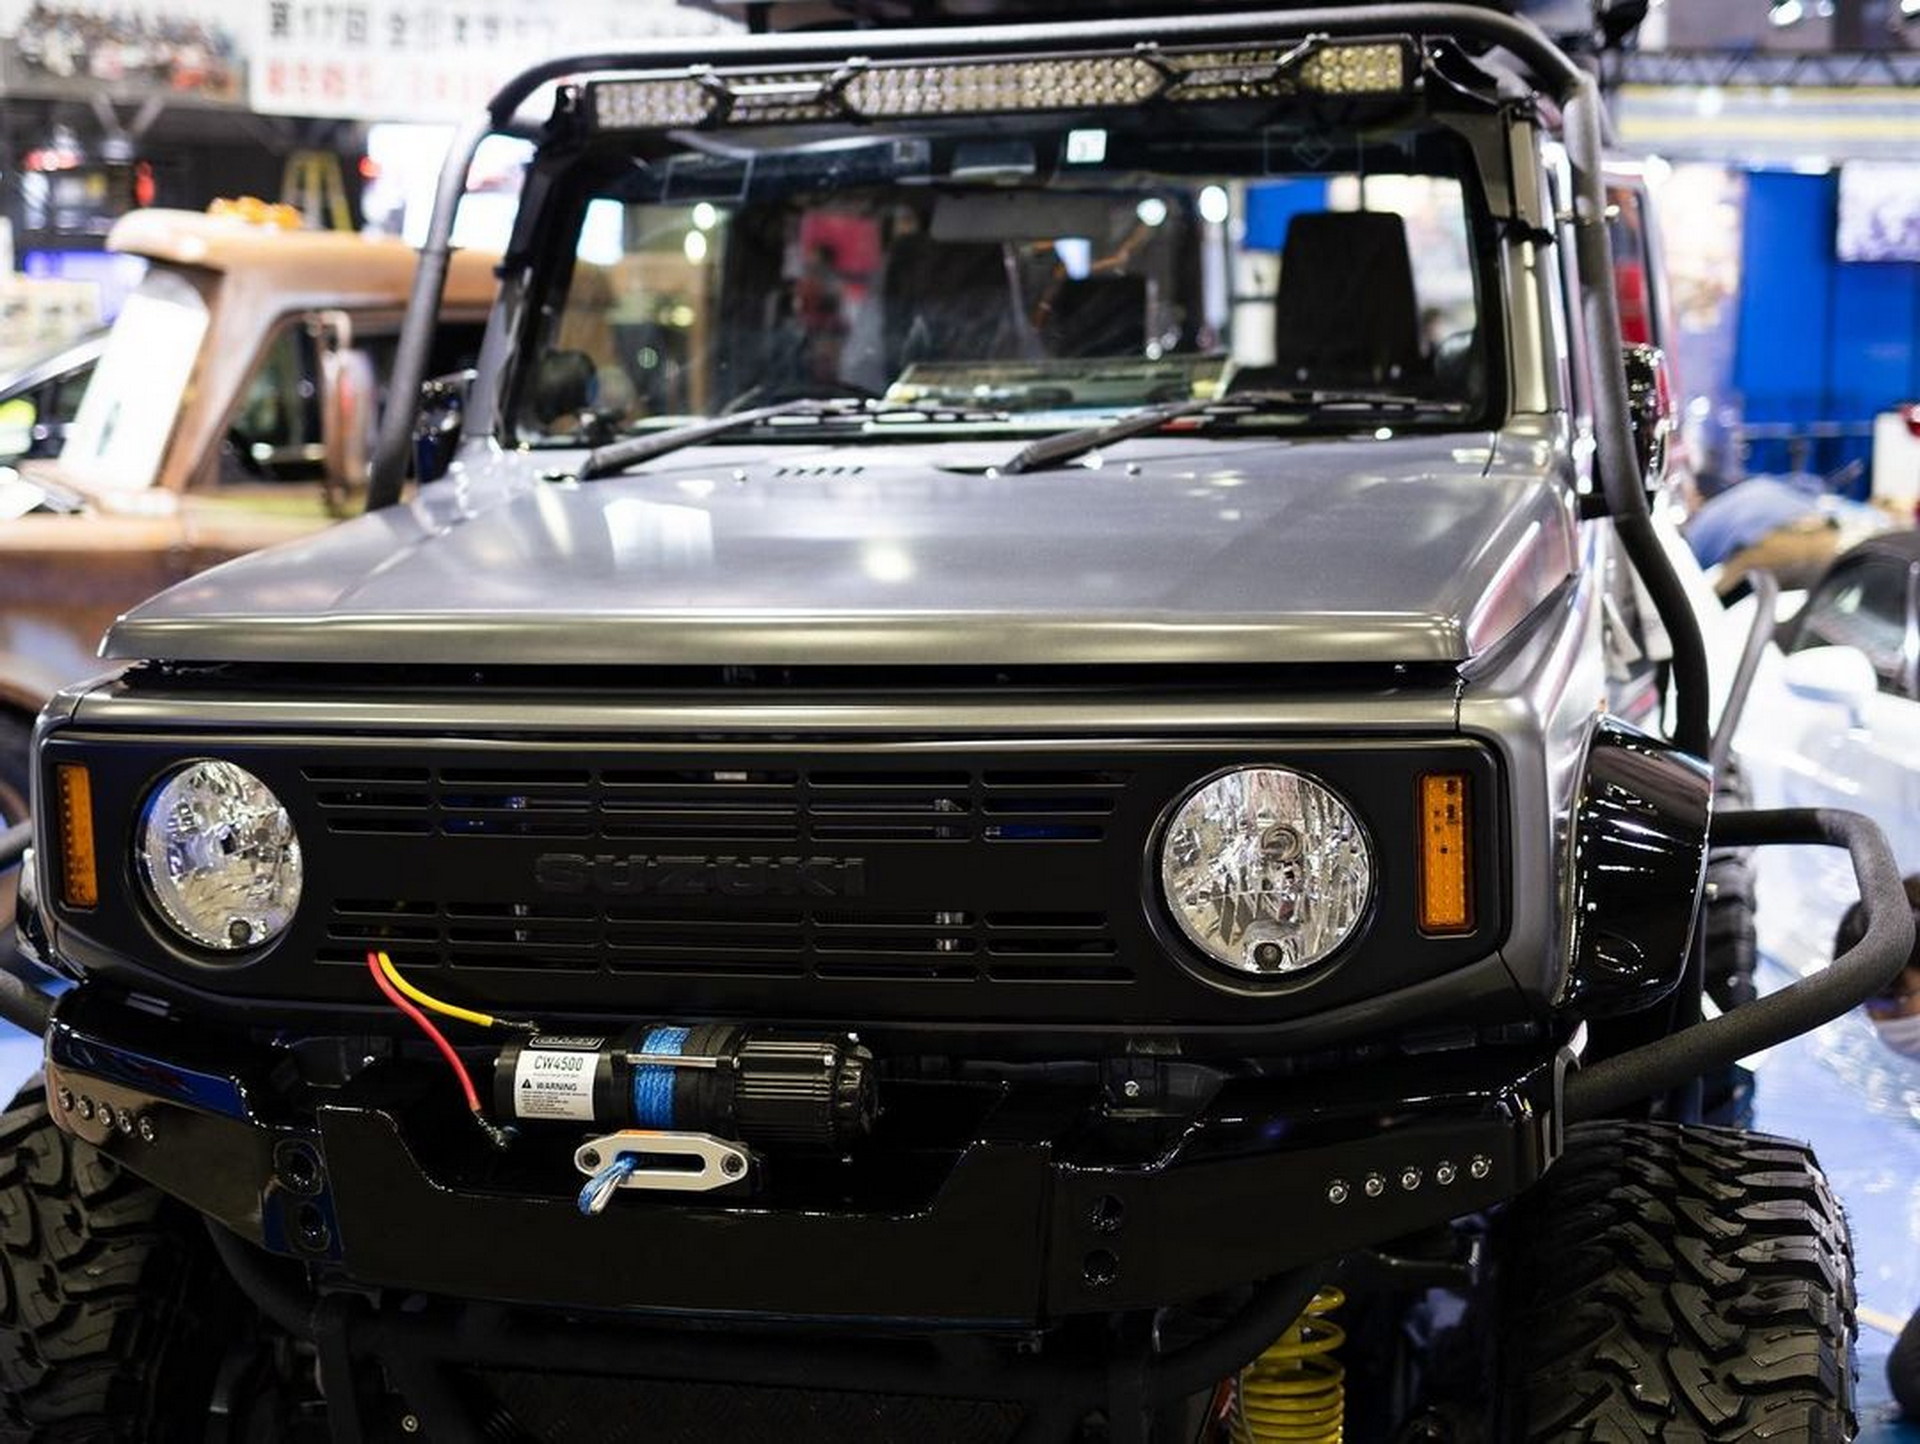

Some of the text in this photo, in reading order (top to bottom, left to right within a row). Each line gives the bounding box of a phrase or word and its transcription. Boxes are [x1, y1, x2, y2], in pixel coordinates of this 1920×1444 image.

[535, 853, 865, 896] SUZUKI
[534, 1055, 584, 1071] CW4500
[536, 1082, 577, 1091] WARNING
